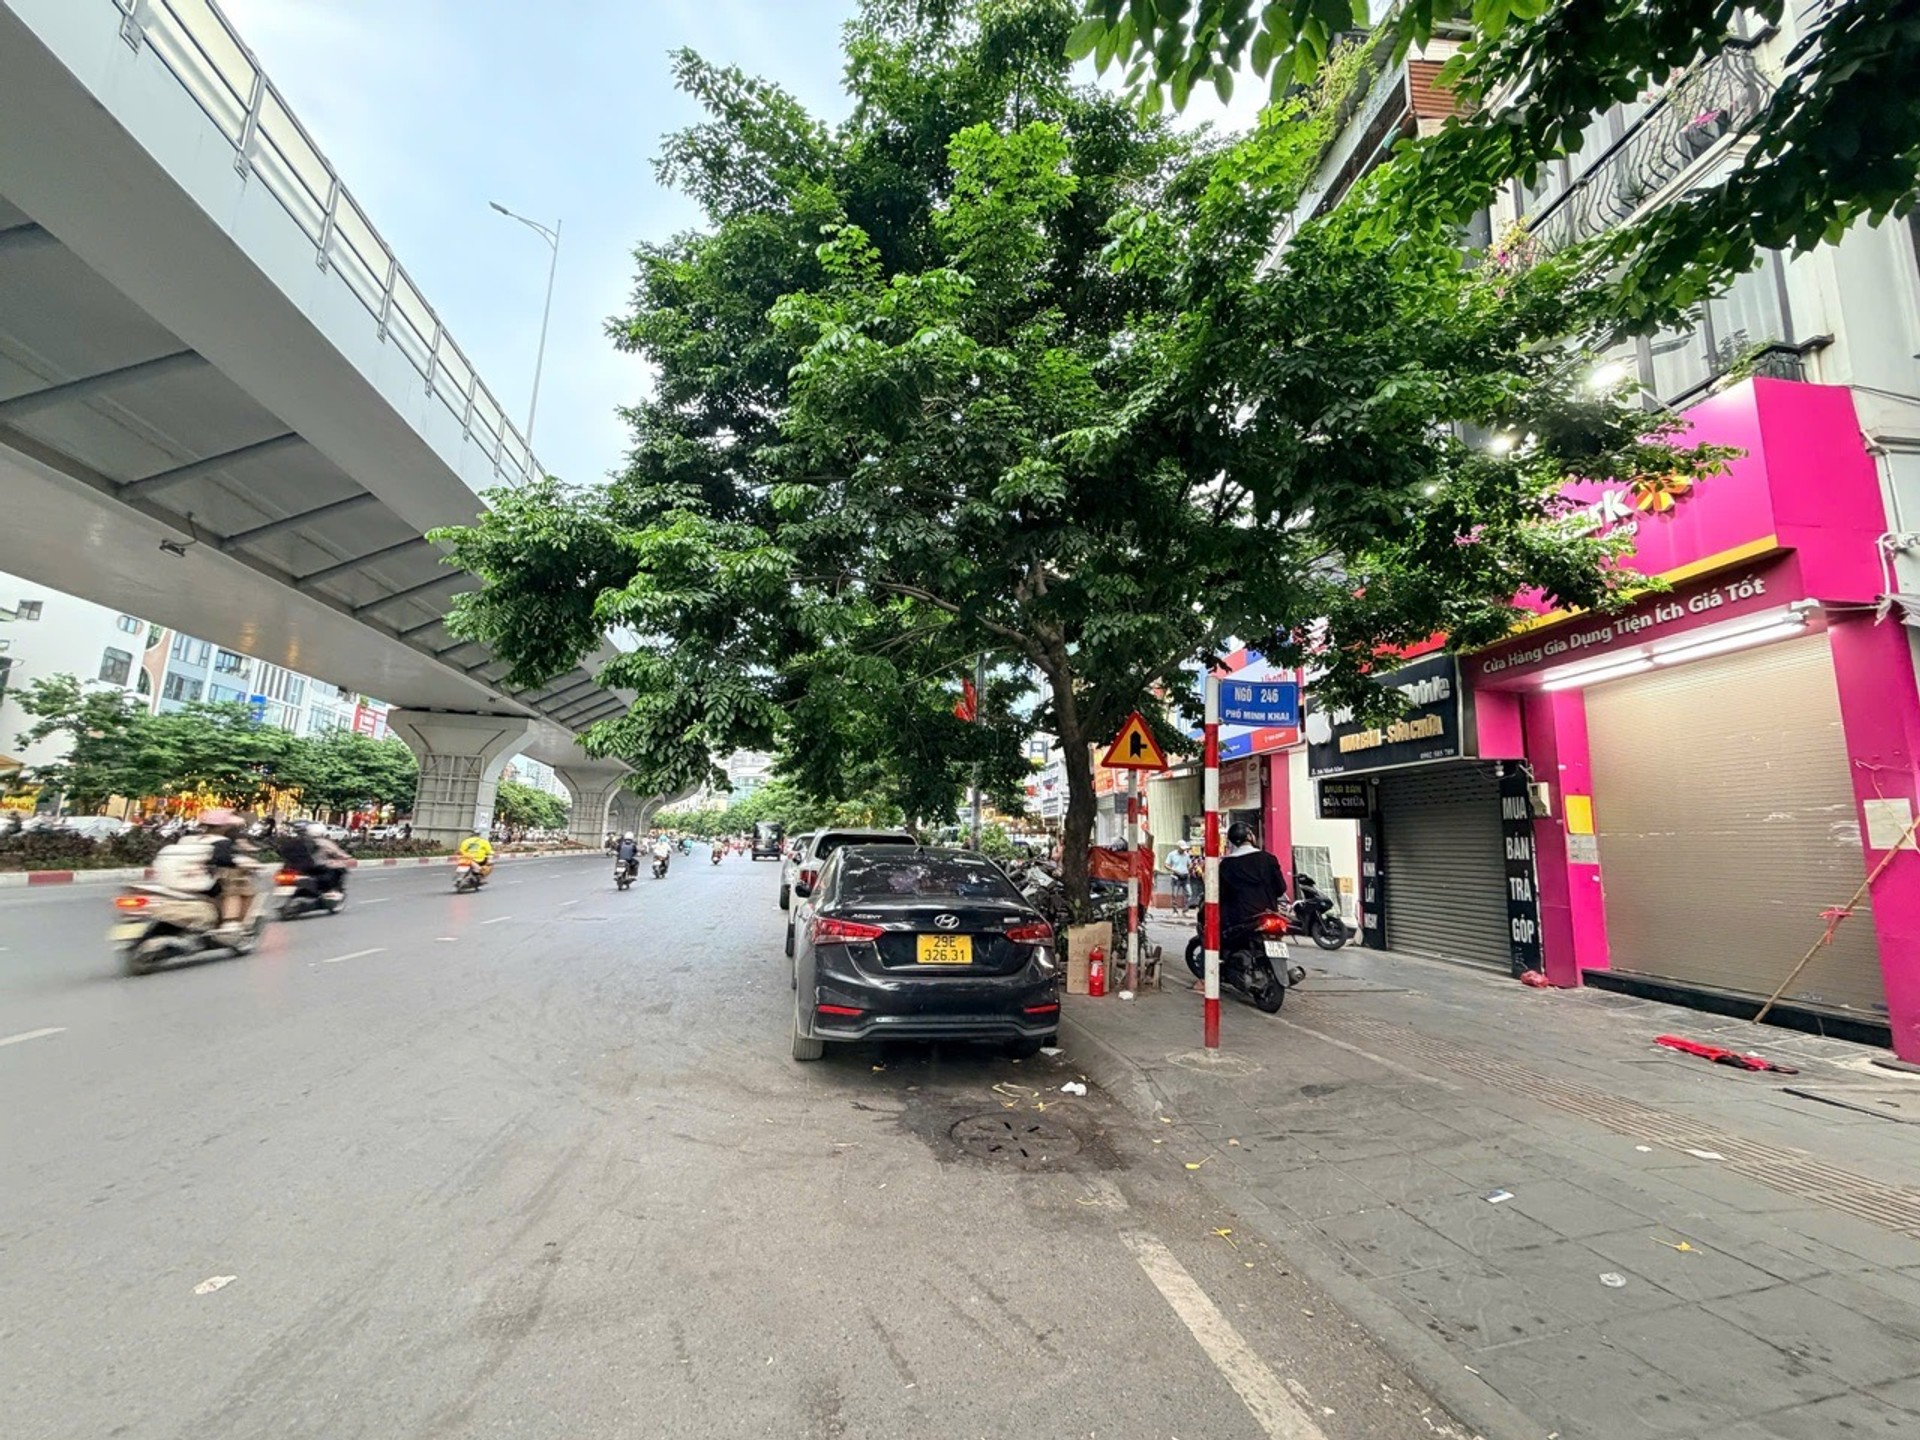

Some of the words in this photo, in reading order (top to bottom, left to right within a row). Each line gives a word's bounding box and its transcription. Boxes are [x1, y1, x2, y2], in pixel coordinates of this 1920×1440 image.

[1483, 658, 1506, 673] Cửa
[1508, 648, 1543, 667] Hàng
[1544, 640, 1569, 656] Gia
[1570, 627, 1613, 649] Dụng
[1614, 614, 1653, 634] Tiện
[1655, 603, 1684, 623] Ích
[1688, 588, 1723, 613] Giá
[1725, 574, 1766, 602] Tốt
[1260, 688, 1279, 703] 246
[1225, 708, 1242, 720] PHỐ
[1243, 711, 1266, 720] MINH
[1267, 712, 1290, 720] KHAI
[1324, 785, 1343, 794] MUA
[1322, 794, 1340, 807] SỬA
[1341, 794, 1365, 807] CHỮA
[1502, 796, 1528, 820] MUA
[1505, 832, 1530, 860] BÁN
[1509, 869, 1532, 902] TRẢ
[1511, 913, 1535, 943] GÓP
[933, 936, 957, 948] 29E
[924, 949, 965, 961] 326.31
